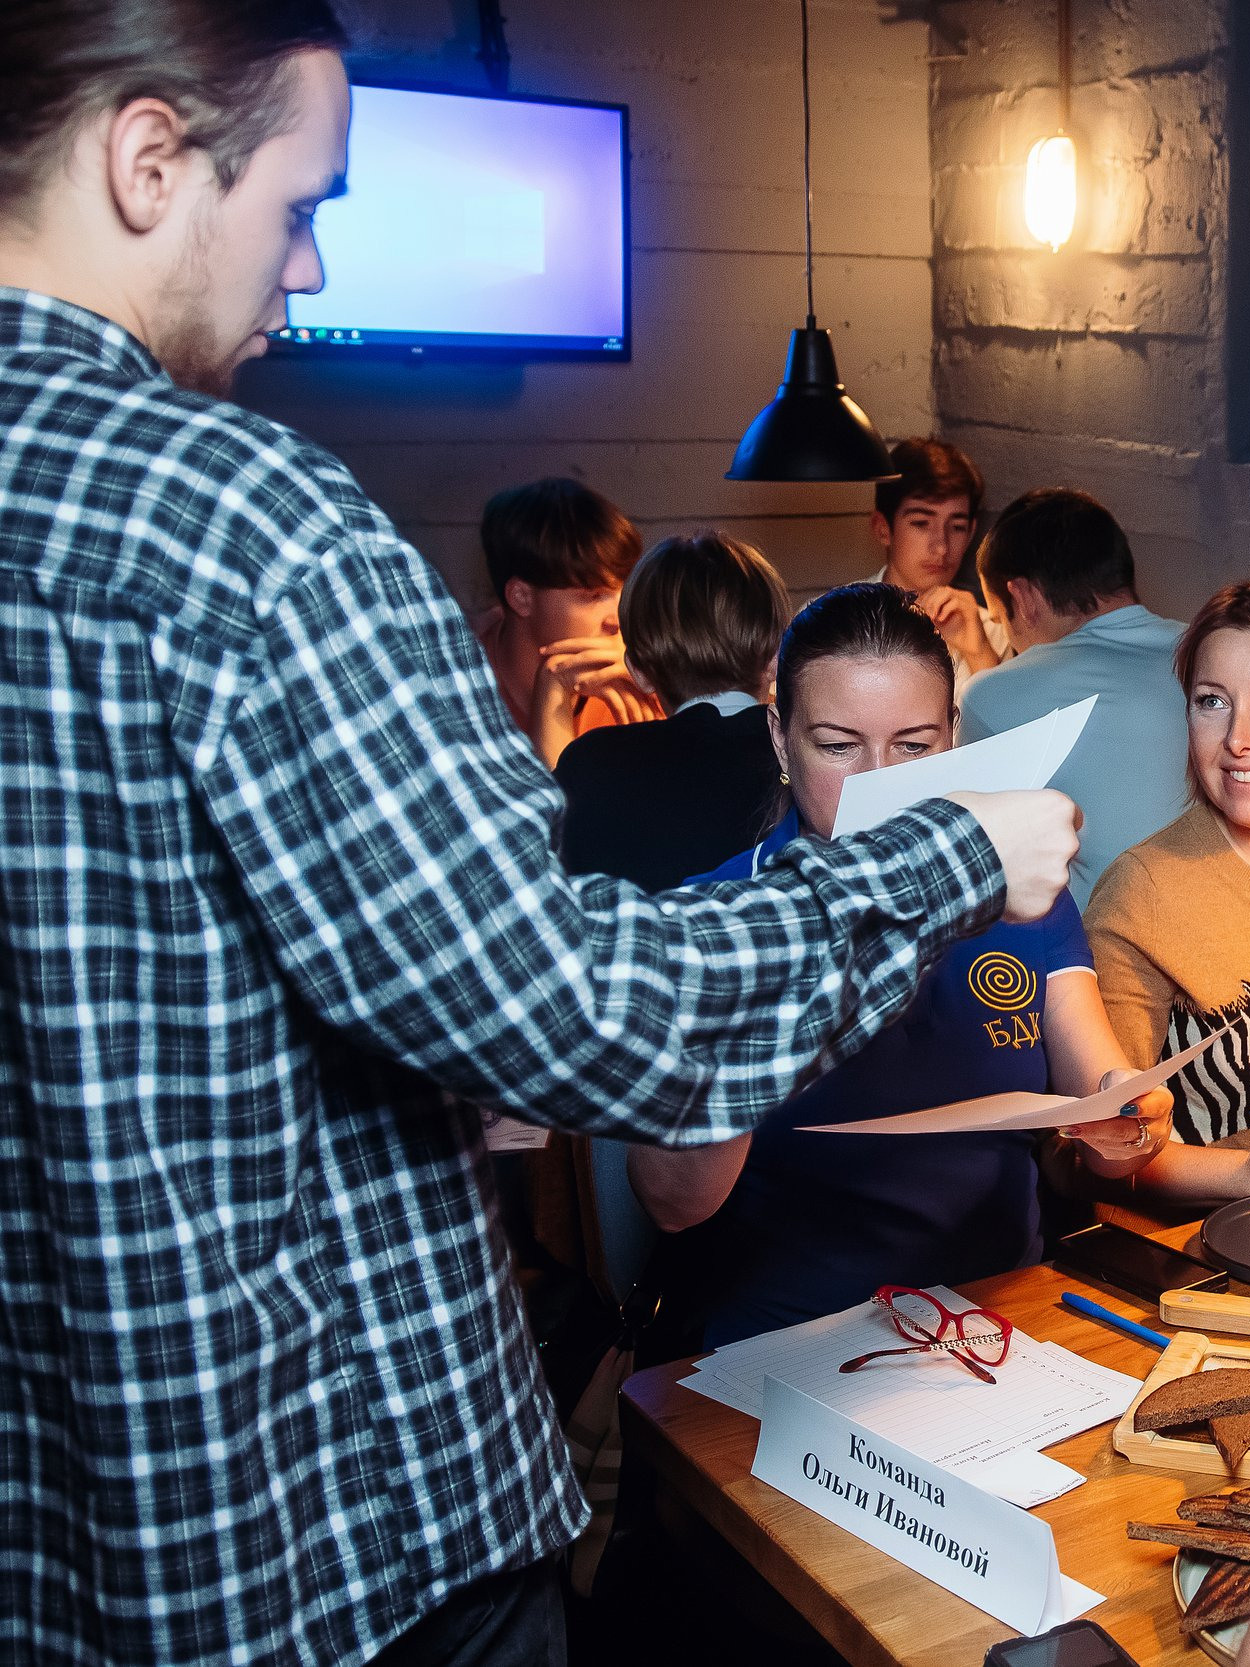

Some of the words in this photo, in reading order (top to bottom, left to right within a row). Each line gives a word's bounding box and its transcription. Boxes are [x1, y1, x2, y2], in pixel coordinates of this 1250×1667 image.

[801, 1452, 869, 1512] Ольги
[874, 1489, 989, 1580] Ивановой
[848, 1432, 946, 1508] Команда
